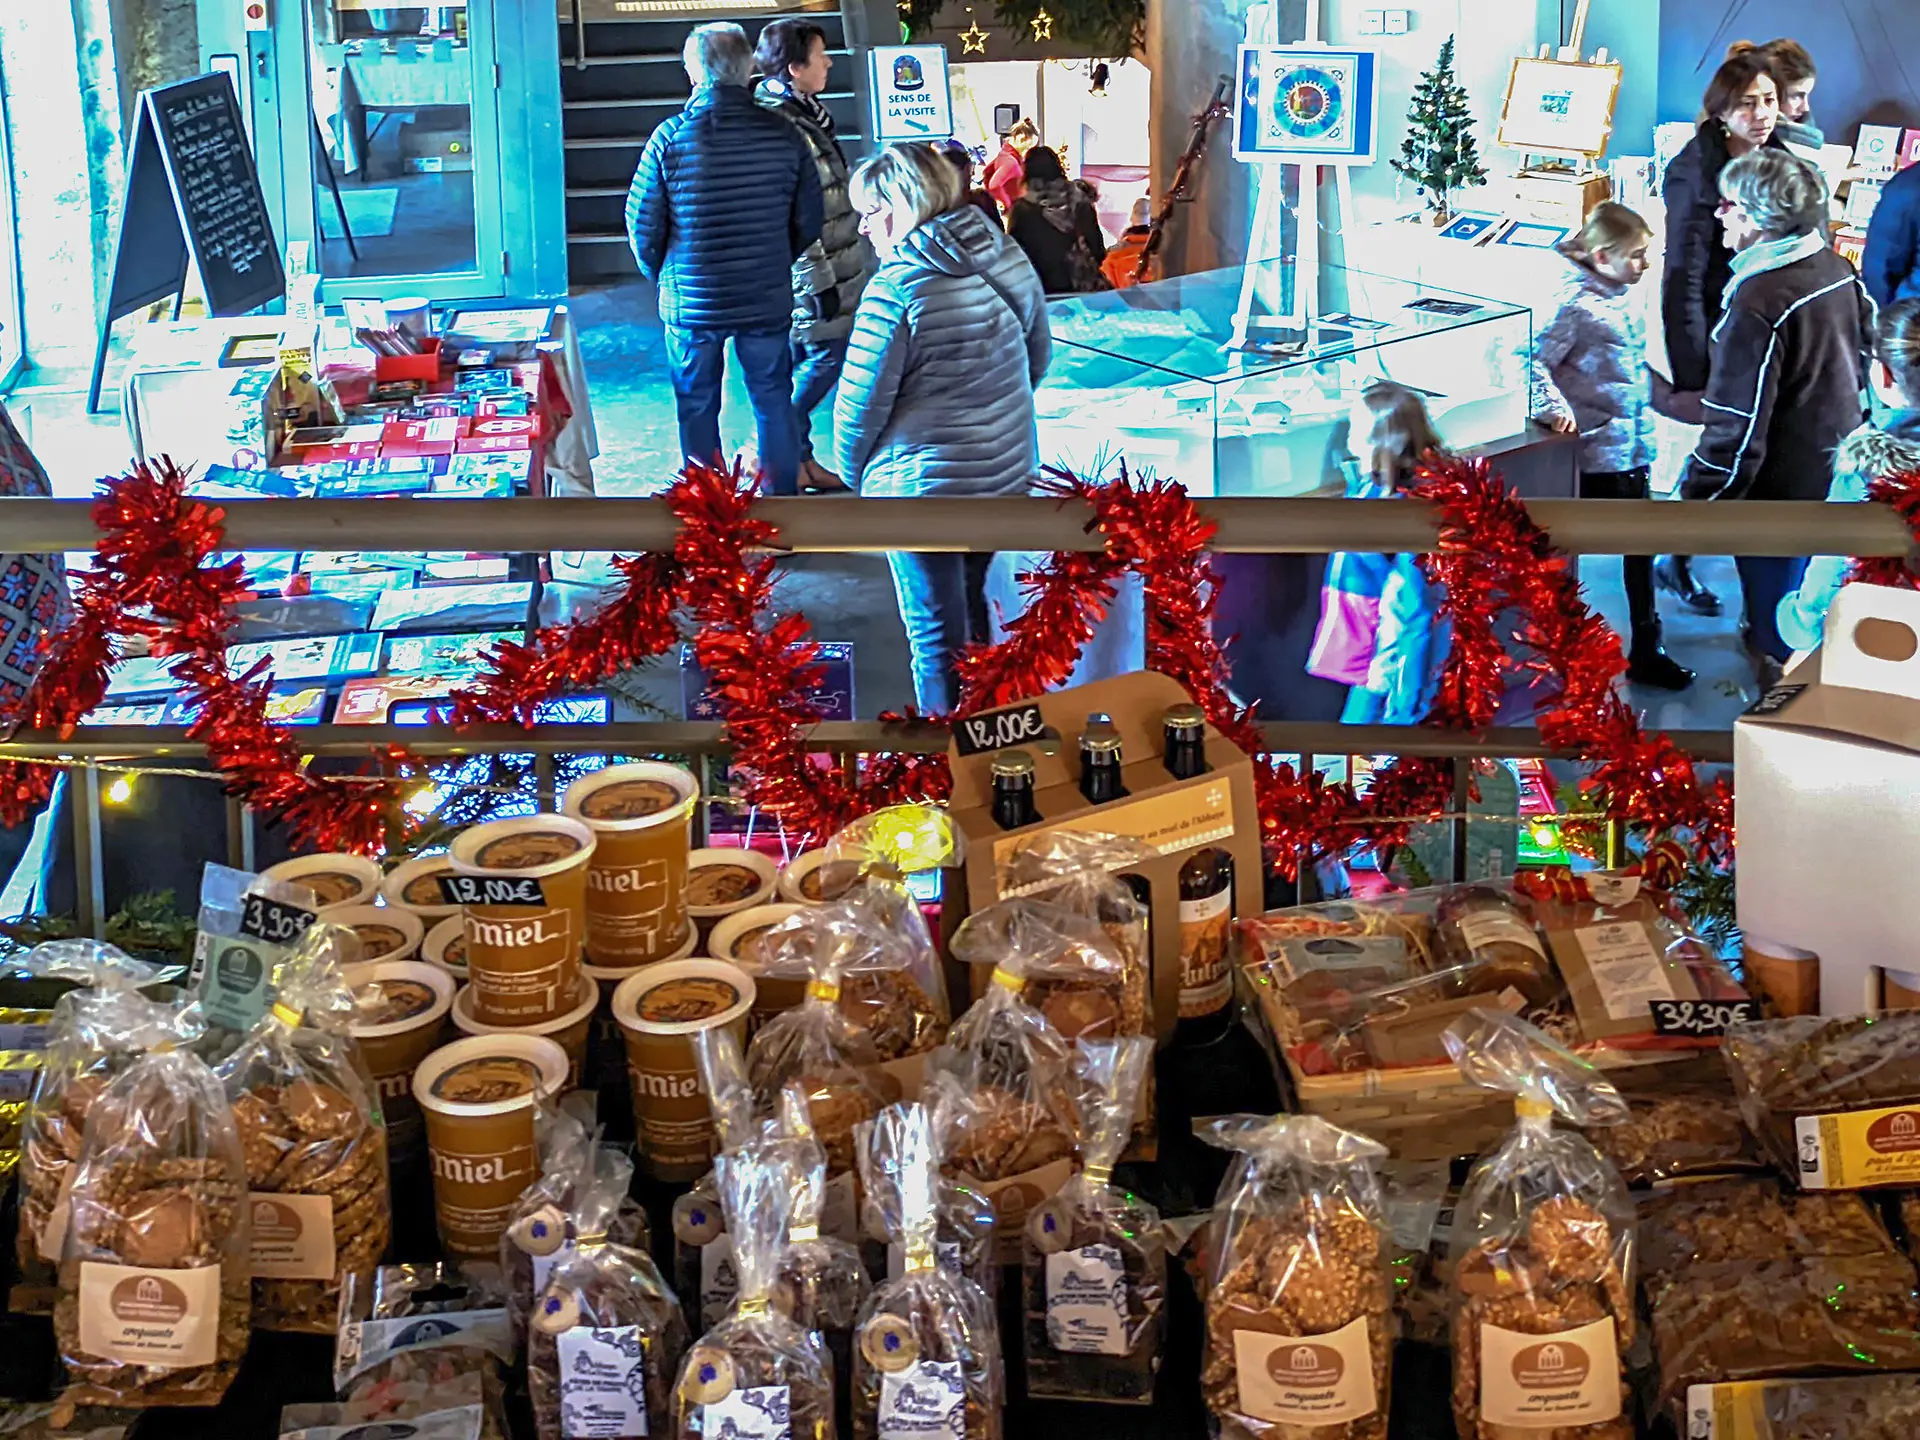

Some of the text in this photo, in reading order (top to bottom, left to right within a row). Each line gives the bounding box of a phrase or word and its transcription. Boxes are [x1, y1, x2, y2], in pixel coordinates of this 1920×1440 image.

[888, 93, 932, 103] SENS DE
[888, 107, 936, 117] LA VISITE
[965, 708, 1045, 748] 12,00€
[447, 877, 543, 903] 12,00€
[1657, 1001, 1751, 1033] 32,30€
